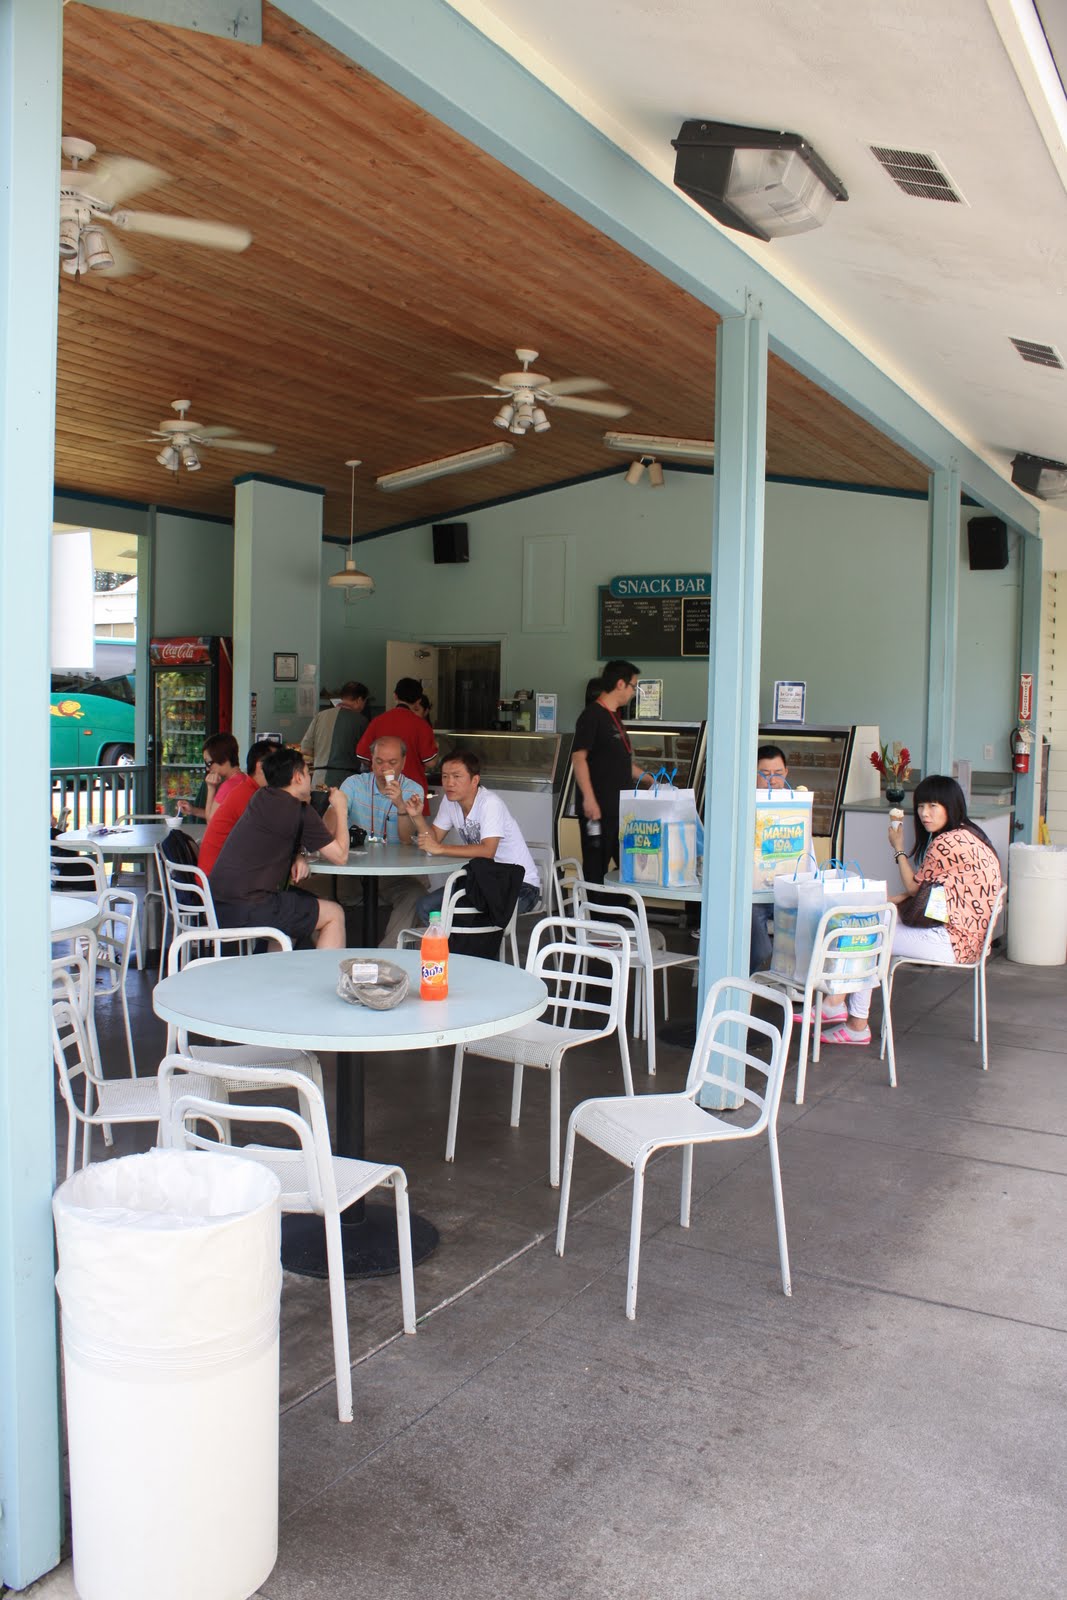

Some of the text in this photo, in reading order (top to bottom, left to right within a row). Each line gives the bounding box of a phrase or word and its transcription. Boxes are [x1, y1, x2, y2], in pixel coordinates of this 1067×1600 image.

[618, 578, 705, 593] SNACK BAR
[763, 825, 803, 840] MAUNA
[773, 839, 793, 852] LOA
